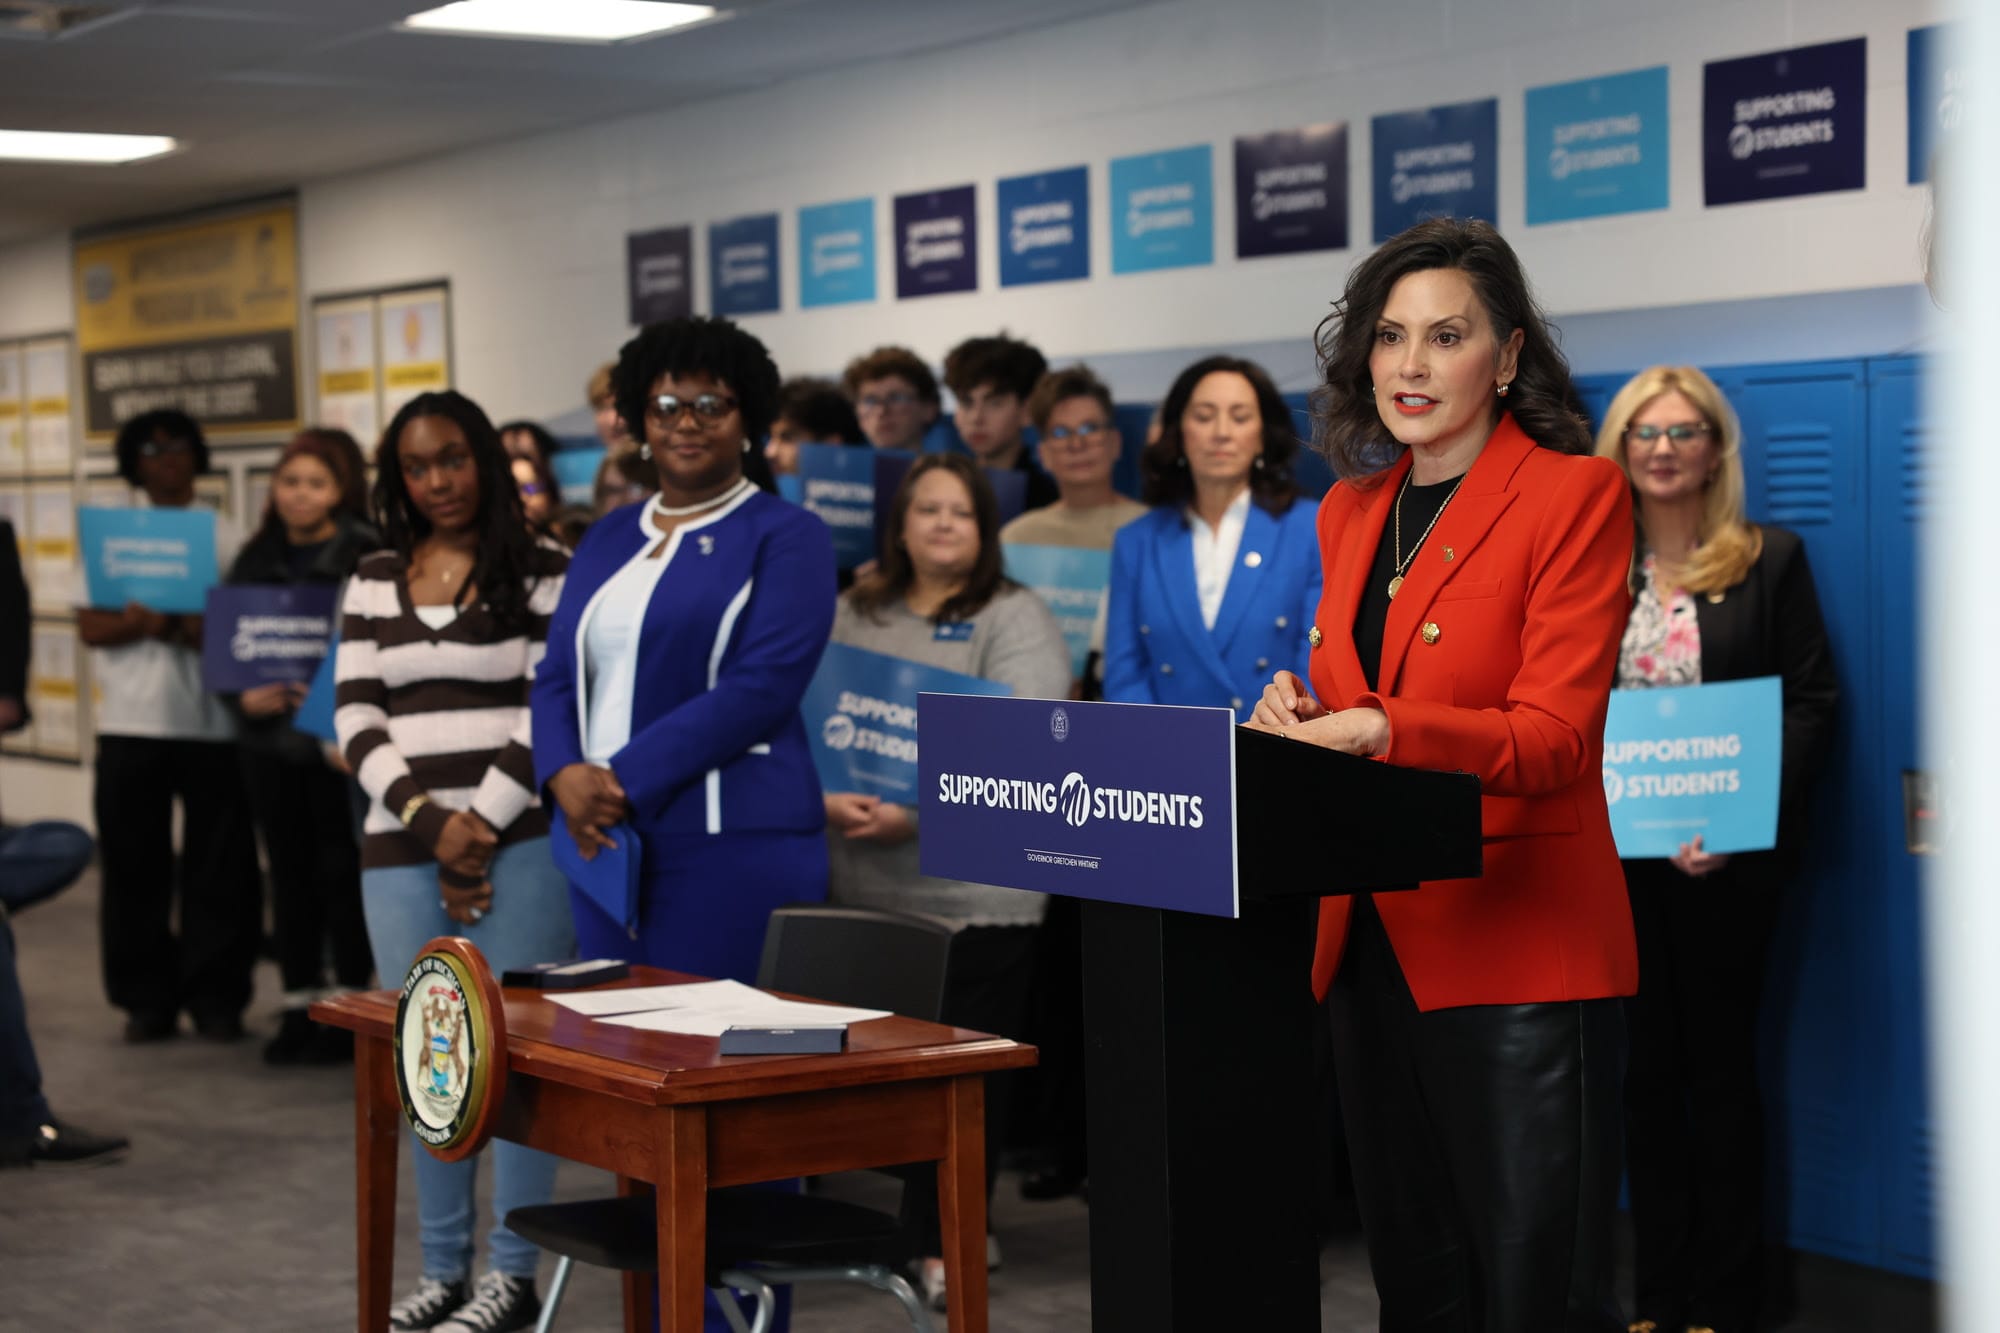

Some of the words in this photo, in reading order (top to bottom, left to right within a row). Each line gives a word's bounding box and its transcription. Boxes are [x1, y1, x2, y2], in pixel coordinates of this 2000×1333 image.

[1734, 87, 1836, 123] SUPPORTING
[1755, 119, 1834, 152] STUDENTS
[837, 691, 918, 731] SUPPOR
[1626, 769, 1741, 798] STUDENTS
[938, 772, 1058, 814] SUPPORTING
[1093, 786, 1205, 829] STUDENTS
[1026, 853, 1053, 863] GOVERNOR
[1053, 856, 1078, 867] GRETCHEN
[1078, 859, 1099, 869] WHITMER
[422, 958, 433, 972] OF
